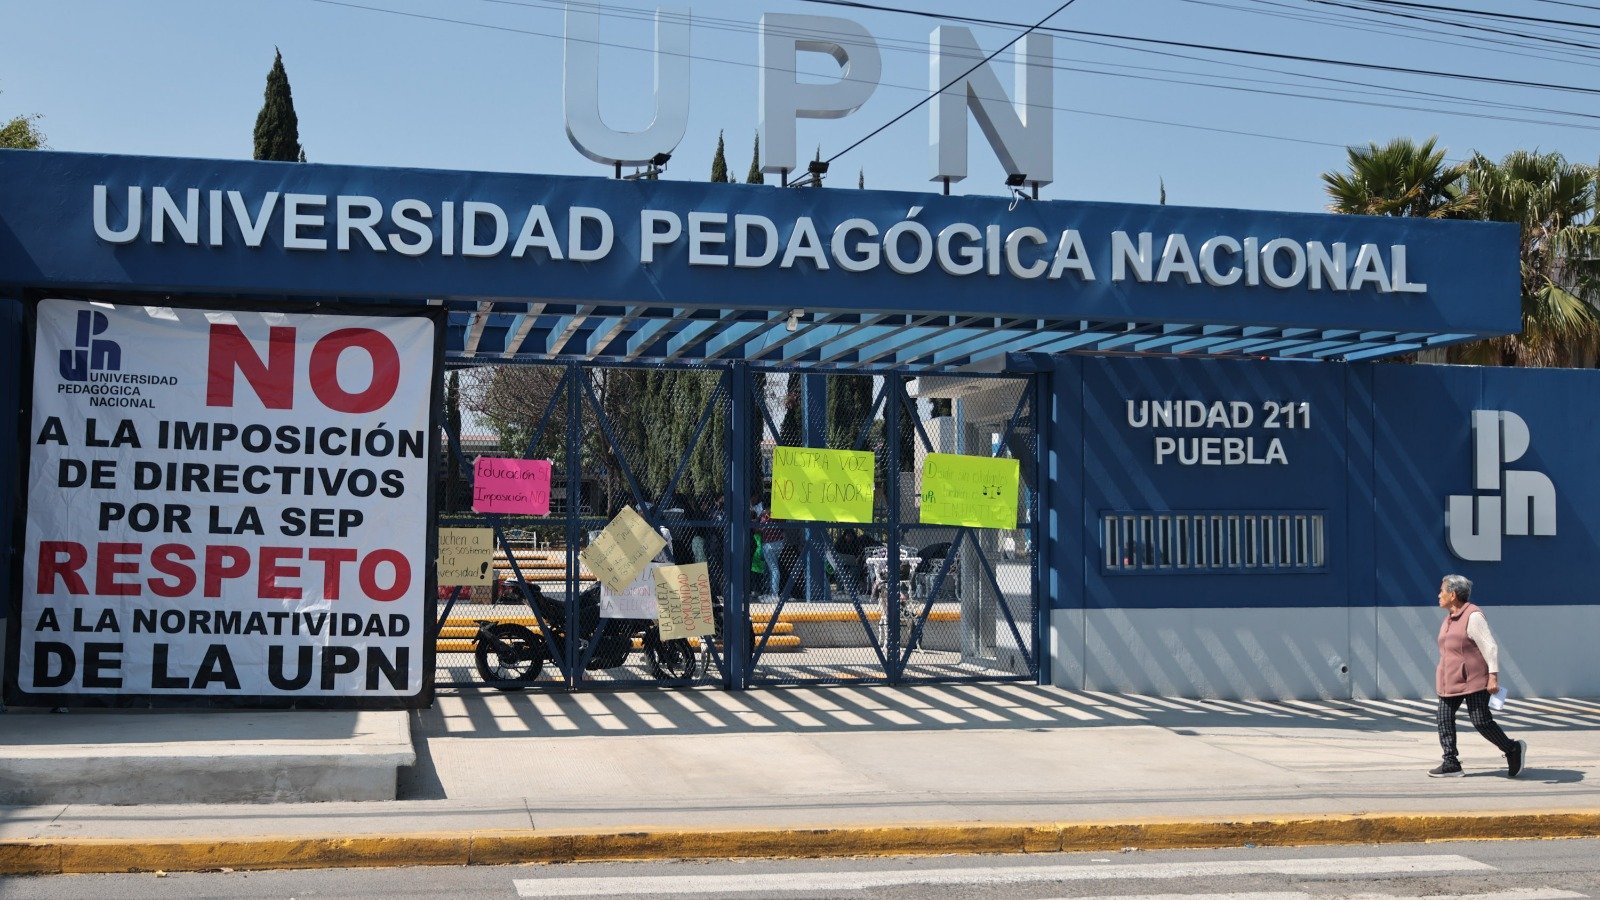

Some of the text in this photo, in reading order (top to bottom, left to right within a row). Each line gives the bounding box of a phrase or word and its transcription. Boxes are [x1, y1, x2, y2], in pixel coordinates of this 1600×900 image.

[563, 0, 1055, 187] UPN
[92, 184, 1427, 294] UNIVERSIDAD PEDAGÓGICA NACIONAL
[90, 372, 178, 386] UNIVERSIDAD
[206, 323, 400, 414] NO
[57, 382, 141, 396] PEDAGÓGICA
[89, 396, 156, 409] NACIONAL
[1127, 400, 1311, 429] UNIDAD 211
[36, 416, 424, 459] A LA IMPOSICIÓN
[1154, 437, 1289, 466] PUEBLA
[477, 459, 535, 480] Educación
[775, 448, 868, 472] NUESTRA VOZ
[57, 458, 405, 499] DE DIRECTIVOS
[773, 479, 874, 504] NO SE IGNORA
[474, 486, 546, 507] Imposición NO
[98, 502, 364, 538] POR LA SEP
[36, 540, 412, 602] RESPETO
[678, 573, 696, 631] COMUNIDAD
[35, 607, 410, 637] A LA NORMATIVIDAD
[661, 621, 673, 632] LA
[32, 641, 410, 691] DE LA UPN
